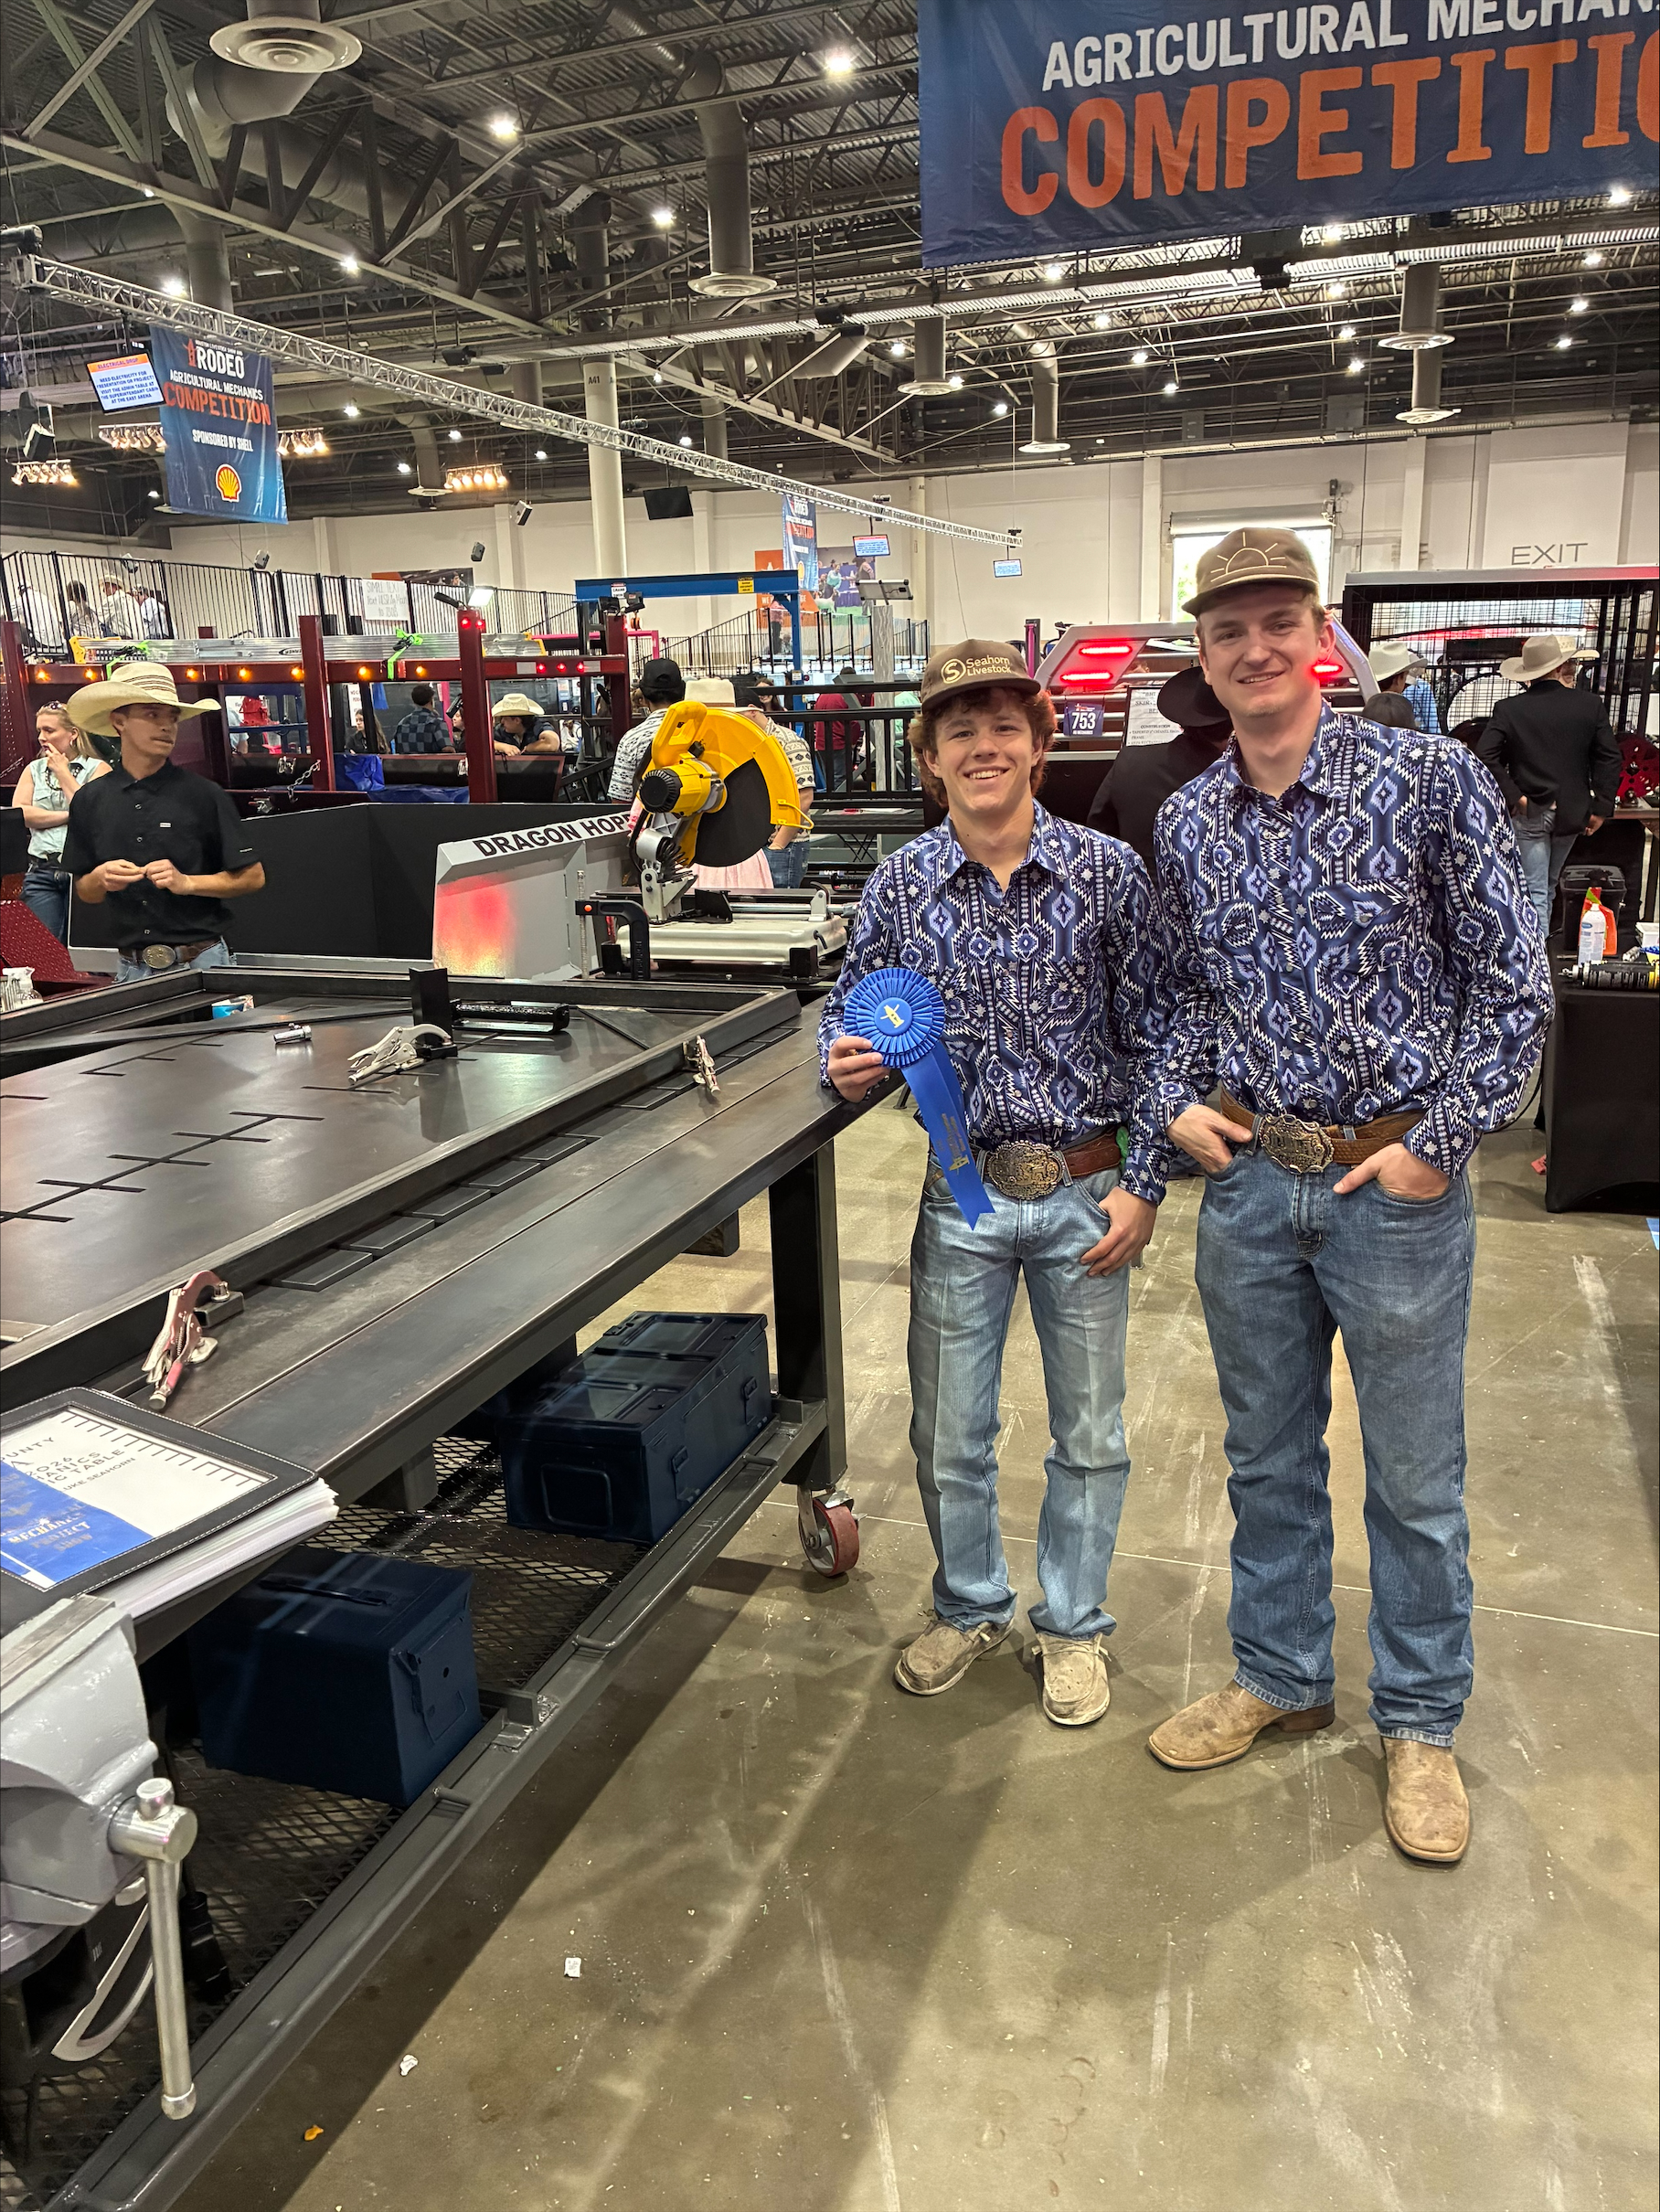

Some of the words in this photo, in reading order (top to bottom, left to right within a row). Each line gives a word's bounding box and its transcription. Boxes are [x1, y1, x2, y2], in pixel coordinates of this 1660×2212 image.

[1042, 4, 1408, 92] AGRICULTURAL
[1427, 0, 1660, 42] MECHA
[97, 359, 126, 369] ELECTRICAL
[197, 346, 245, 379] RODEO
[112, 372, 137, 380] ELECTRICITY
[170, 368, 222, 393] AGRICULTURAL
[223, 381, 264, 401] MECHANICS
[163, 381, 271, 426] COMPETITION
[192, 429, 229, 448] SPONSORED
[229, 435, 238, 449] BY
[237, 437, 254, 452] SHELL
[1511, 542, 1589, 566] EXIT
[965, 654, 1010, 668] Seahorn
[967, 664, 1012, 676] Livestock
[1071, 712, 1096, 729] 753
[472, 824, 581, 857] DRAGON
[69, 1449, 125, 1473] TABLE
[61, 1480, 88, 1492] UKE
[87, 1457, 136, 1482] SEAHORN
